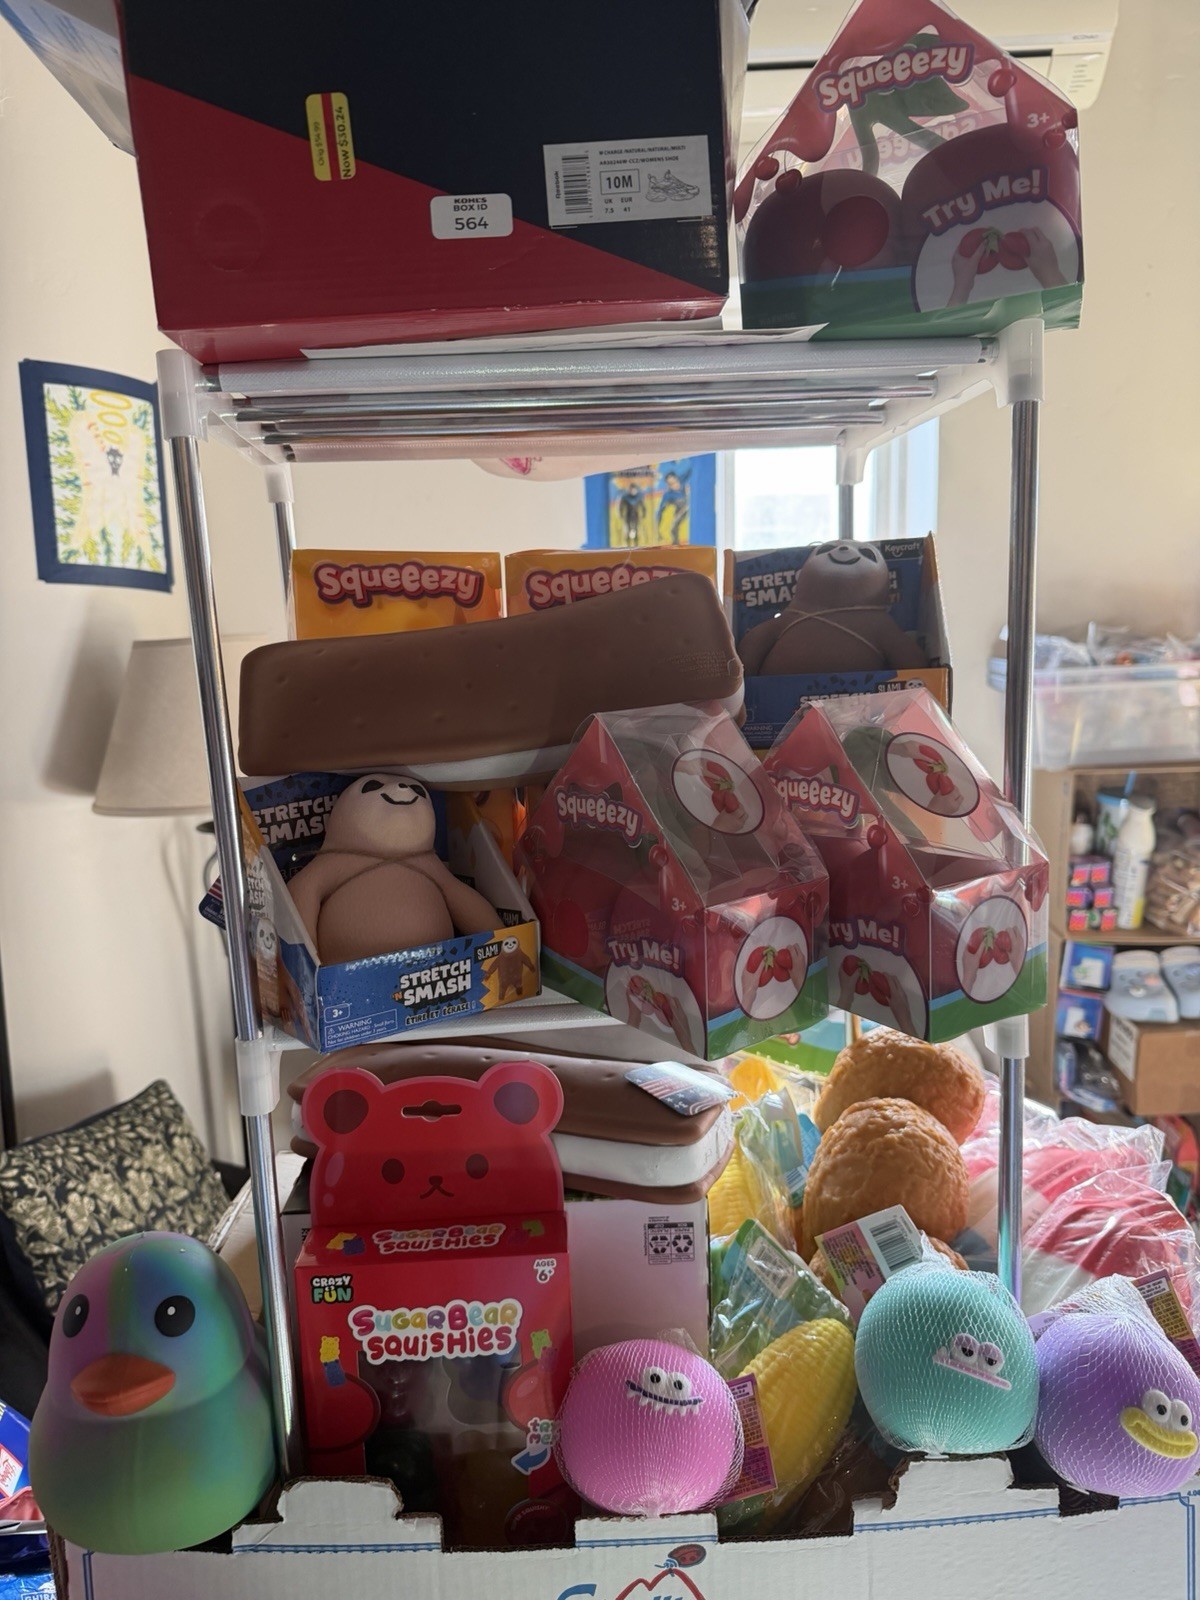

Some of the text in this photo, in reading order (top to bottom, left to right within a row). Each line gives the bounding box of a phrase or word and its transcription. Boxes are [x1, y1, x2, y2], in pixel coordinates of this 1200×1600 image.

[817, 45, 969, 105] Squeeezy
[1027, 111, 1051, 128] 3+
[334, 106, 352, 178] Now $30.24
[606, 175, 633, 190] 10M
[922, 168, 1042, 228] Try Me!
[453, 203, 488, 212] BOX ID
[455, 216, 489, 231] 564
[884, 542, 920, 554] Keycraft
[317, 563, 481, 603] Squeeezy
[556, 792, 640, 838] Squeeezy
[891, 876, 909, 889] 3+
[671, 897, 687, 912] 3+
[857, 918, 899, 948] Me!
[608, 939, 681, 970] Try Me!
[400, 959, 471, 989] STRETCH
[403, 974, 471, 1007] SMASH
[332, 1008, 343, 1019] 3+
[338, 1017, 371, 1032] WARNING
[535, 1259, 555, 1268] AGES
[312, 1275, 351, 1287] CRAZY
[313, 1286, 352, 1303] FUN
